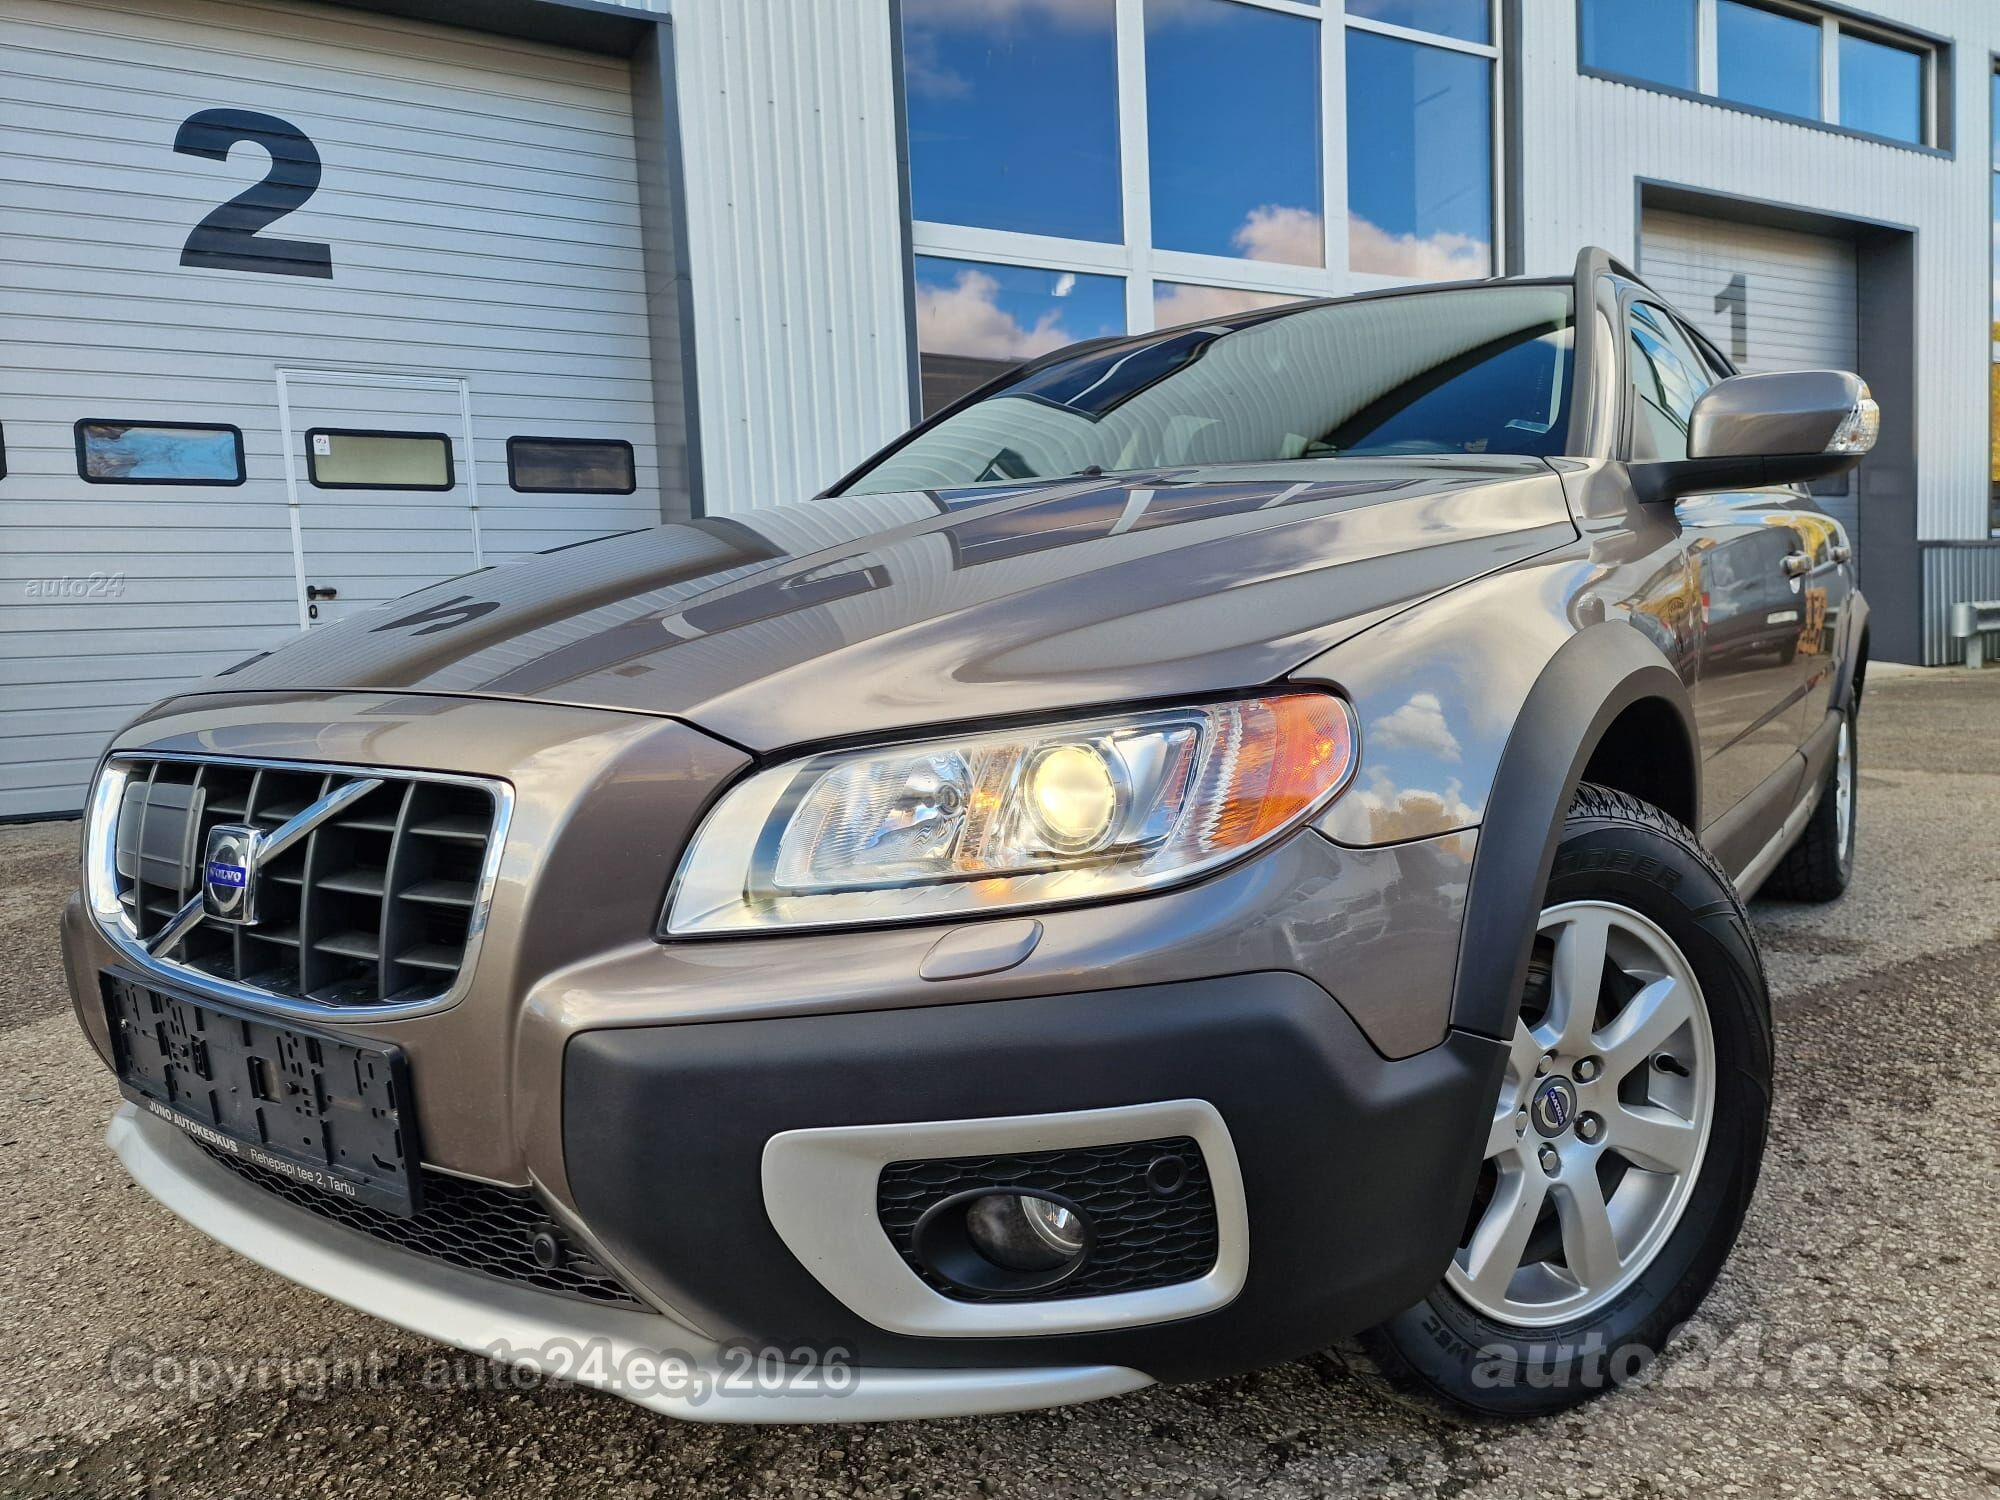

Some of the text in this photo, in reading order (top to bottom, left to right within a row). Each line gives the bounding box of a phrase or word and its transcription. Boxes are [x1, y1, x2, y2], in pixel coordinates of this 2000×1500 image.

[173, 108, 333, 280] 2
[1714, 272, 1747, 363] 1
[209, 867, 242, 883] VOLVO
[149, 1101, 355, 1196] JUNO AUTOKESKUS Rehepapi tee 2, Tartu
[1549, 1091, 1564, 1125] VOLVO
